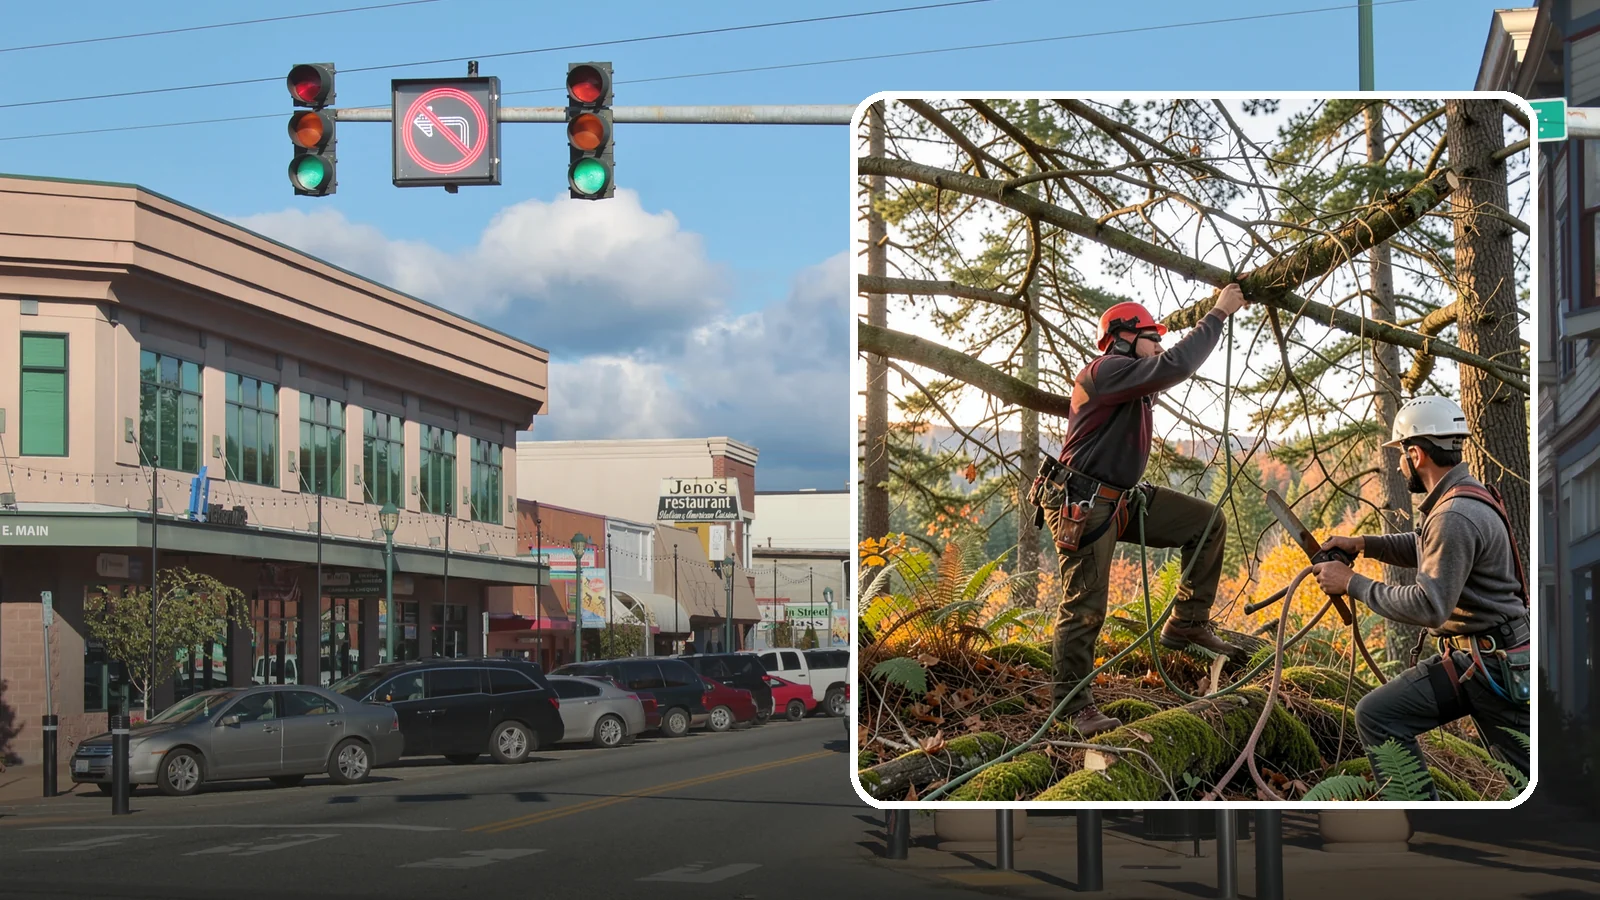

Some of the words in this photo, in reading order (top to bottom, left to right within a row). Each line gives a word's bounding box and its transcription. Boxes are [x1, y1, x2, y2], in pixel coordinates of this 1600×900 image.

[669, 480, 728, 495] Jeno's
[665, 496, 731, 509] restaurant
[658, 510, 682, 519] Italian
[686, 510, 715, 519] American
[715, 510, 738, 519] Cuisine
[2, 525, 13, 536] E.
[15, 525, 49, 536] MAIN
[797, 607, 828, 617] Street
